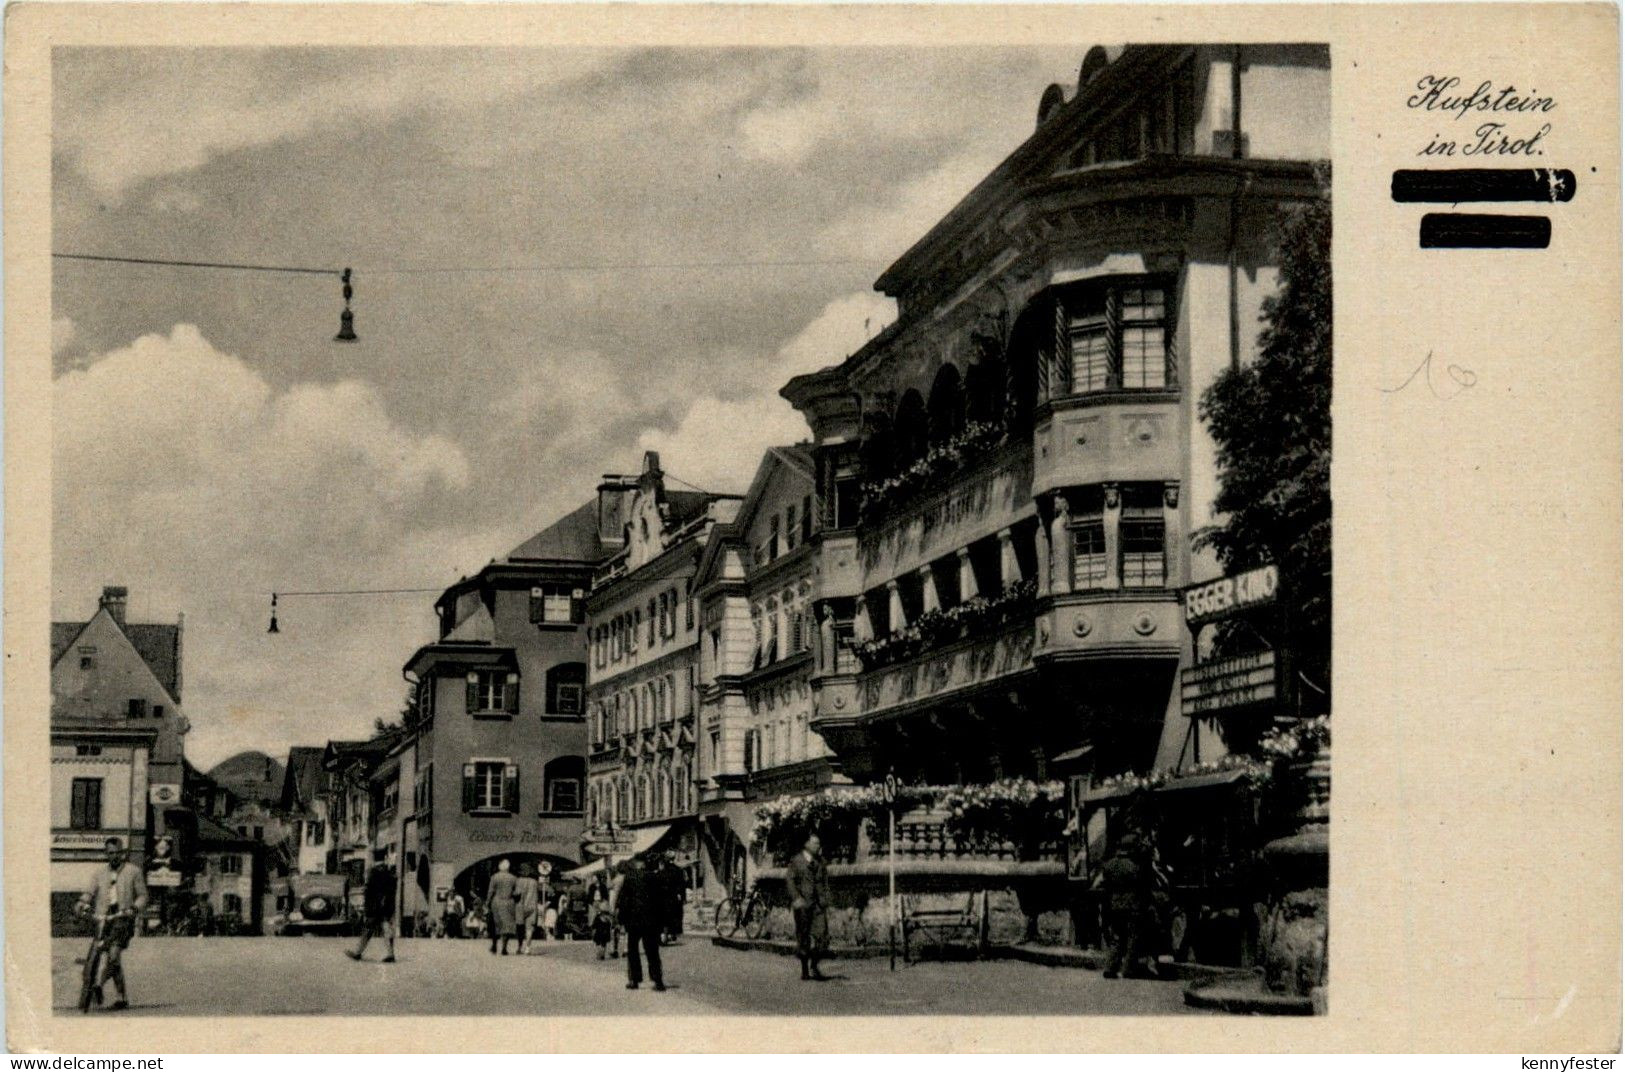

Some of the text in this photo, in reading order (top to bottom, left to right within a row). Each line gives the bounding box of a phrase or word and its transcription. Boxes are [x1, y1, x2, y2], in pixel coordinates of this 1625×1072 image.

[1407, 75, 1557, 120] Kufstein
[1417, 122, 1552, 156] in Tirol.
[1186, 565, 1279, 620] EGGER KINO
